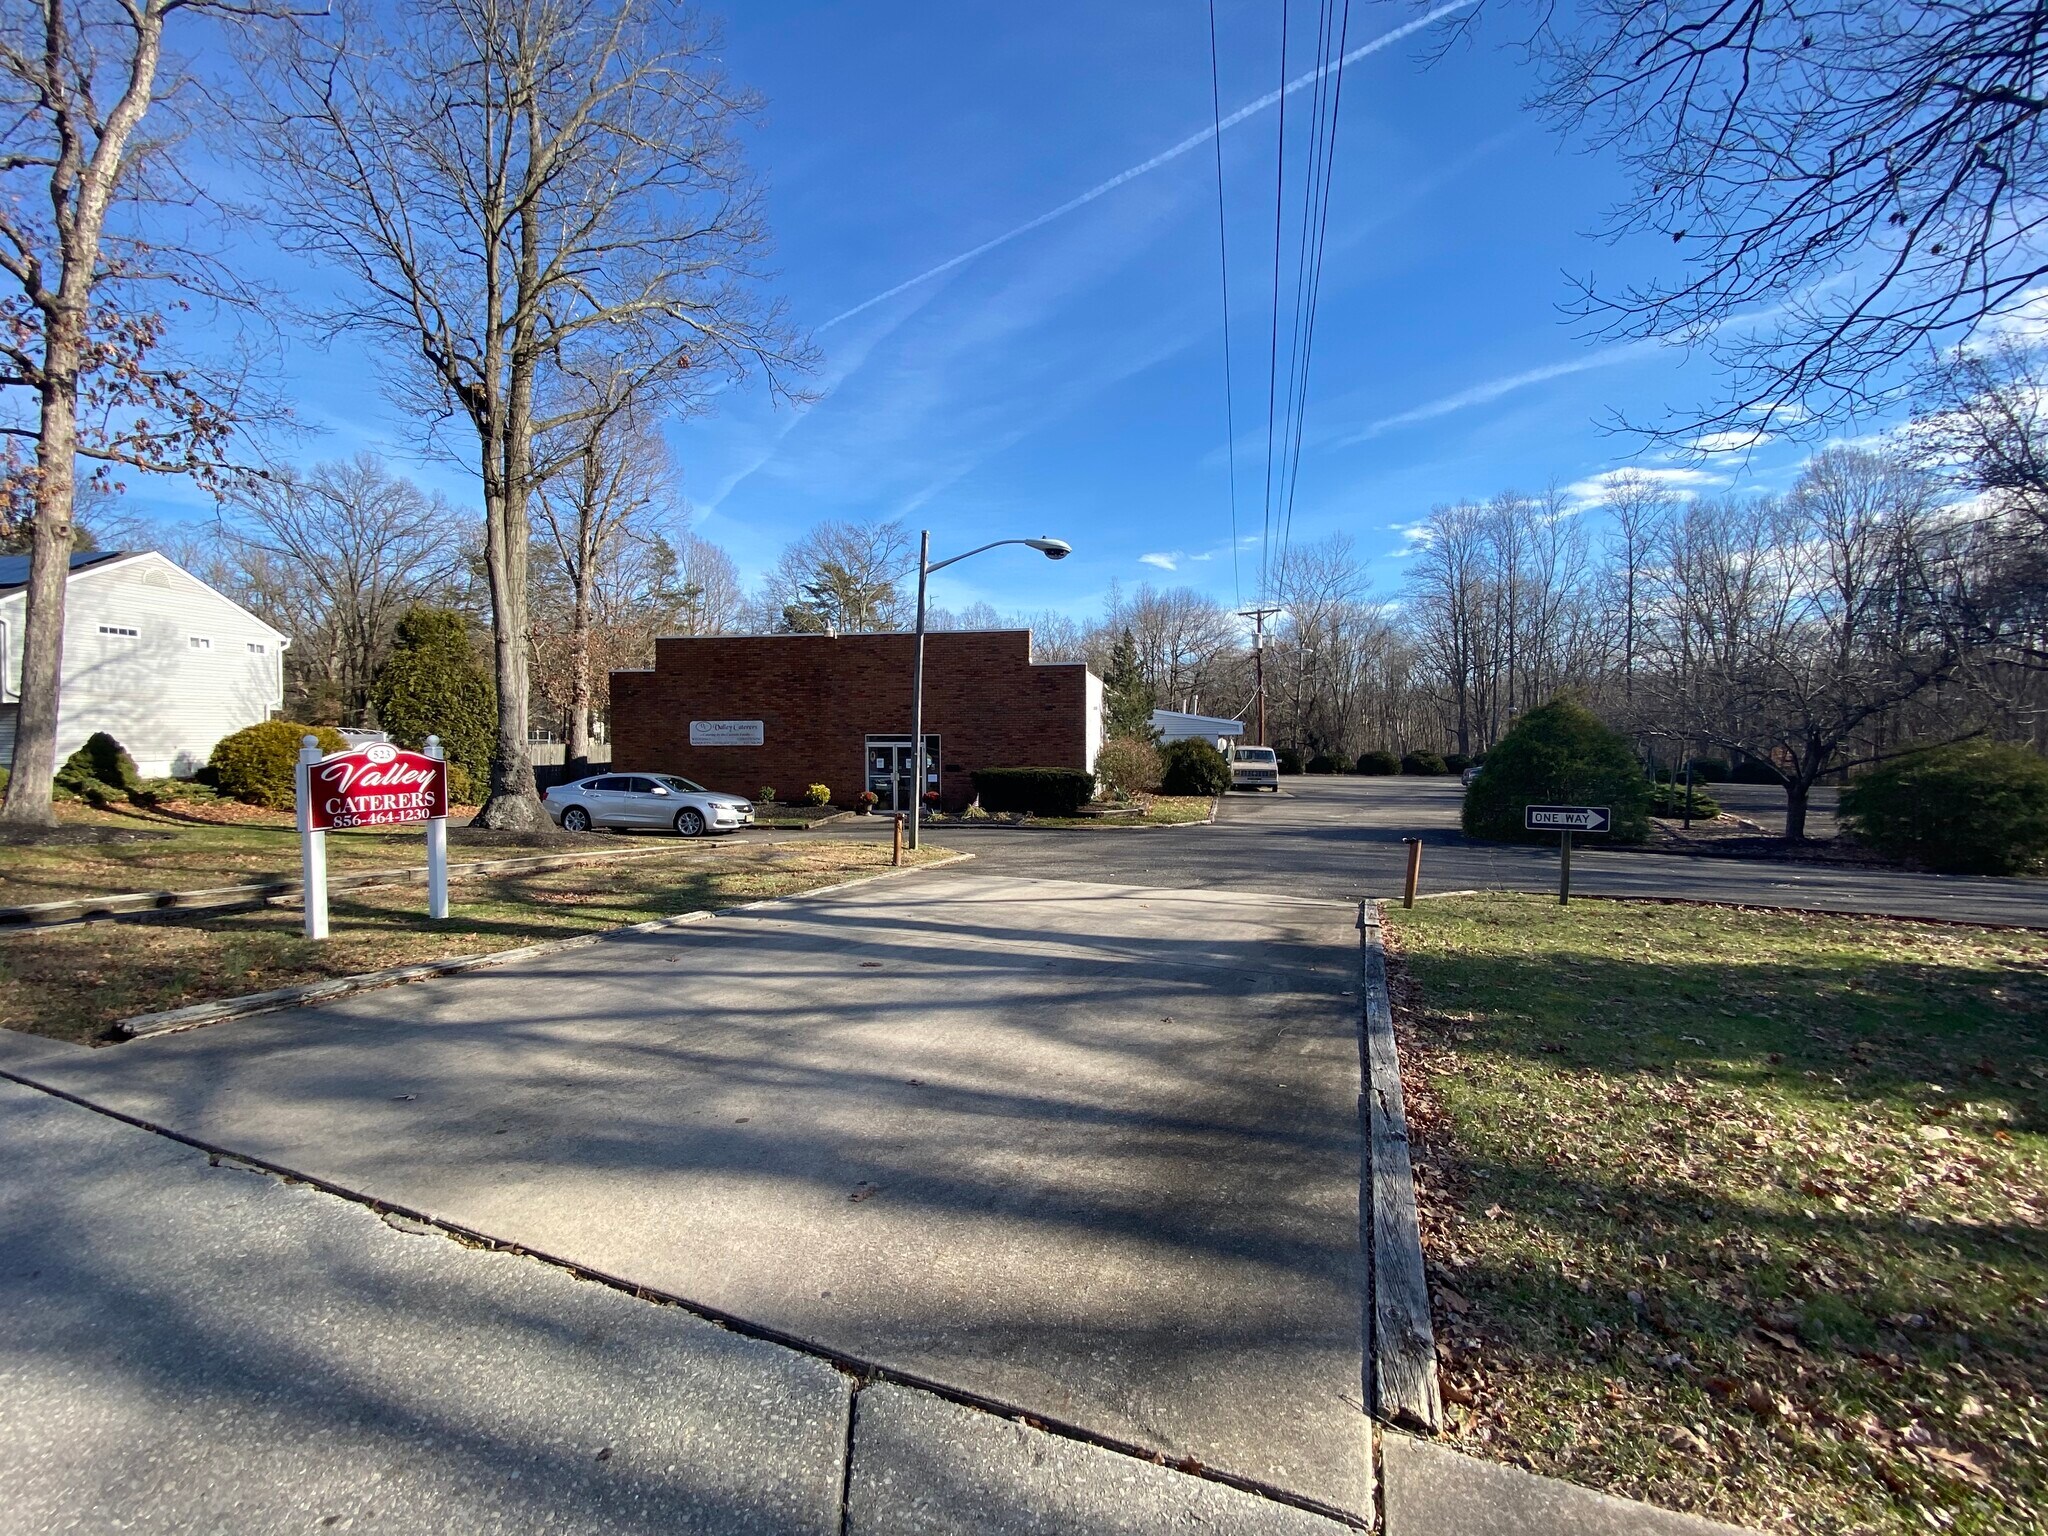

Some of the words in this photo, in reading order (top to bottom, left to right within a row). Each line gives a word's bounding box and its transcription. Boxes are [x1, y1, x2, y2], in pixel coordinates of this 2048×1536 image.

[713, 724, 732, 732] Valley
[373, 750, 391, 760] 523
[321, 762, 437, 794] Valley
[325, 792, 435, 814] CATERERS
[333, 809, 430, 828] 856-464-1230
[1535, 813, 1559, 823] ONE
[1565, 813, 1590, 824] WAY
